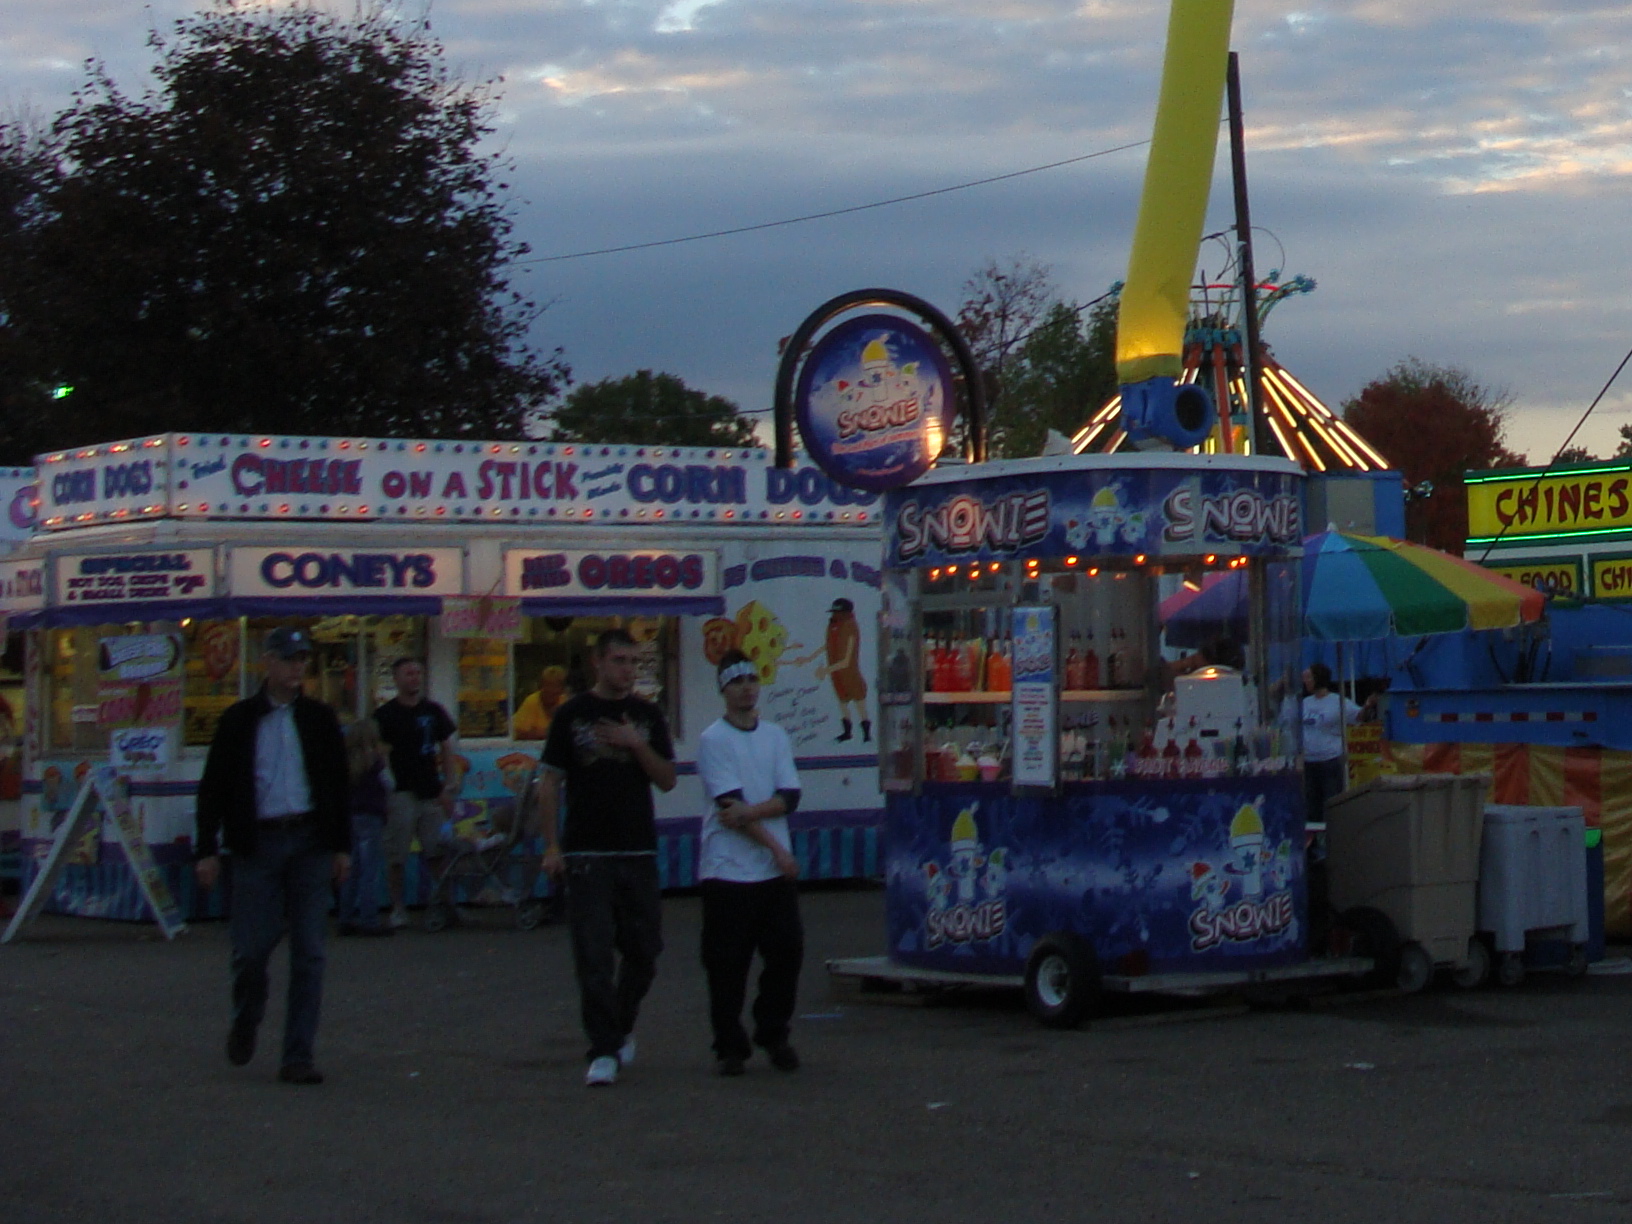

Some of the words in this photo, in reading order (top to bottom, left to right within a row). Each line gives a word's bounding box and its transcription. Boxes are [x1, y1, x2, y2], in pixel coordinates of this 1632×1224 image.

[837, 398, 918, 439] SNOWIE
[382, 470, 435, 498] ON
[441, 471, 467, 498] A
[478, 459, 579, 500] STICK
[627, 463, 747, 504] CORN
[900, 488, 1051, 556] SNOWIE
[261, 552, 436, 588] CONEYS
[578, 553, 704, 589] OREOS
[925, 902, 1004, 948] SNOWIE
[1189, 892, 1294, 951] SNOWIE
